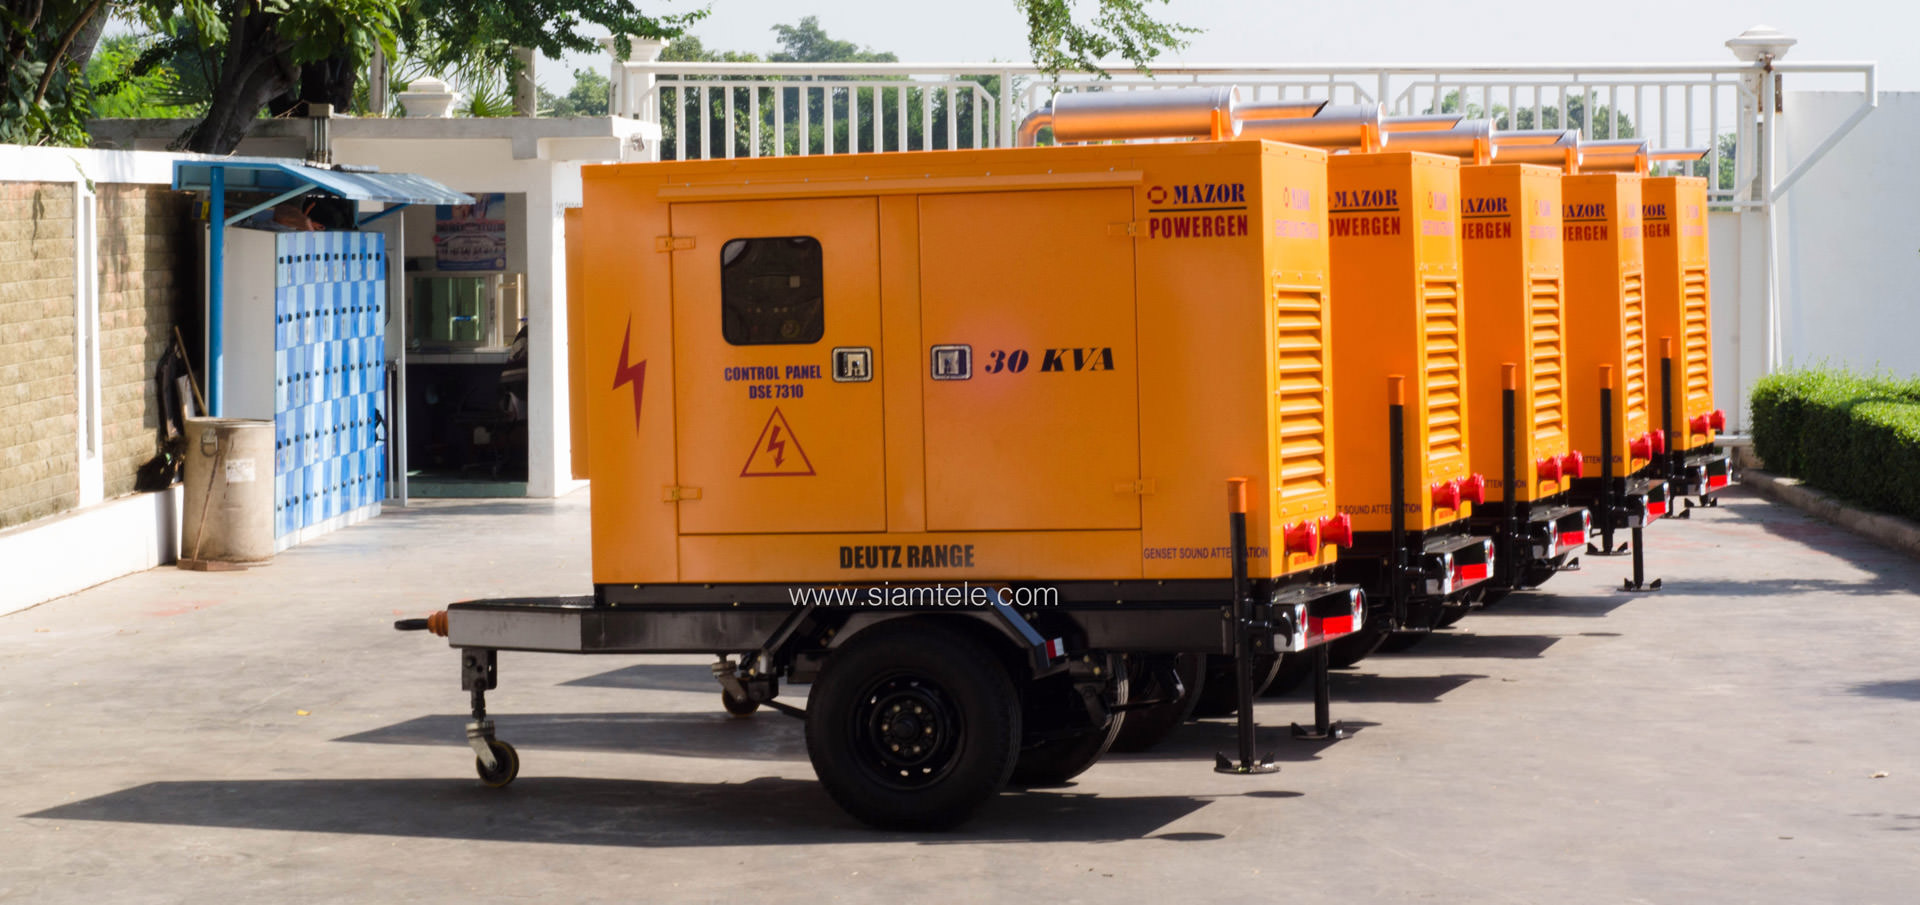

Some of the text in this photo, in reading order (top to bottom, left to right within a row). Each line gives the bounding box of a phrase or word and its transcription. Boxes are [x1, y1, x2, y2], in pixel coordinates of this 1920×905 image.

[1173, 183, 1246, 205] MAZOR
[1334, 189, 1398, 209] MAZOR
[1562, 203, 1606, 218] AZOR
[1149, 214, 1249, 240] POWERGEN
[984, 347, 1116, 375] 30 KVA
[724, 364, 823, 382] CONTROL PANEL
[748, 382, 805, 400] DSE 7310
[839, 543, 975, 570] DEUTZ RANGE
[1143, 547, 1178, 560] GENSET
[1178, 547, 1209, 560] SOUND
